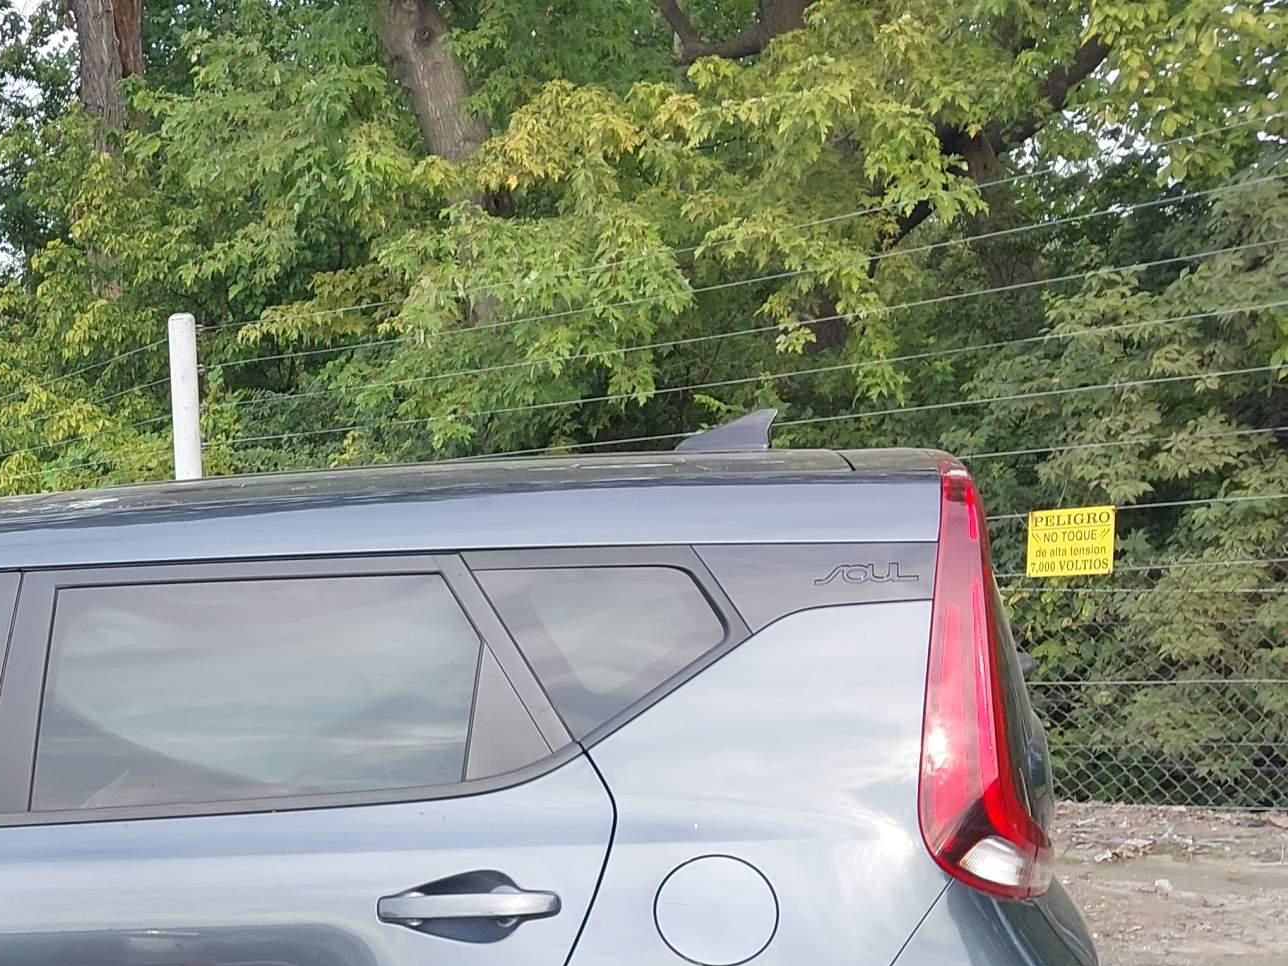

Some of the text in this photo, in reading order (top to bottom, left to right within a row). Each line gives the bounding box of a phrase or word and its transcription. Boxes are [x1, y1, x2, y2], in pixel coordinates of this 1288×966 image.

[1033, 511, 1111, 527] PELIGRO
[1043, 529, 1098, 543] NO TOQUE
[1035, 544, 1106, 558] de alta tension
[814, 562, 919, 585] SOUL
[1031, 558, 1109, 574] 7,000 VOLTIOS
